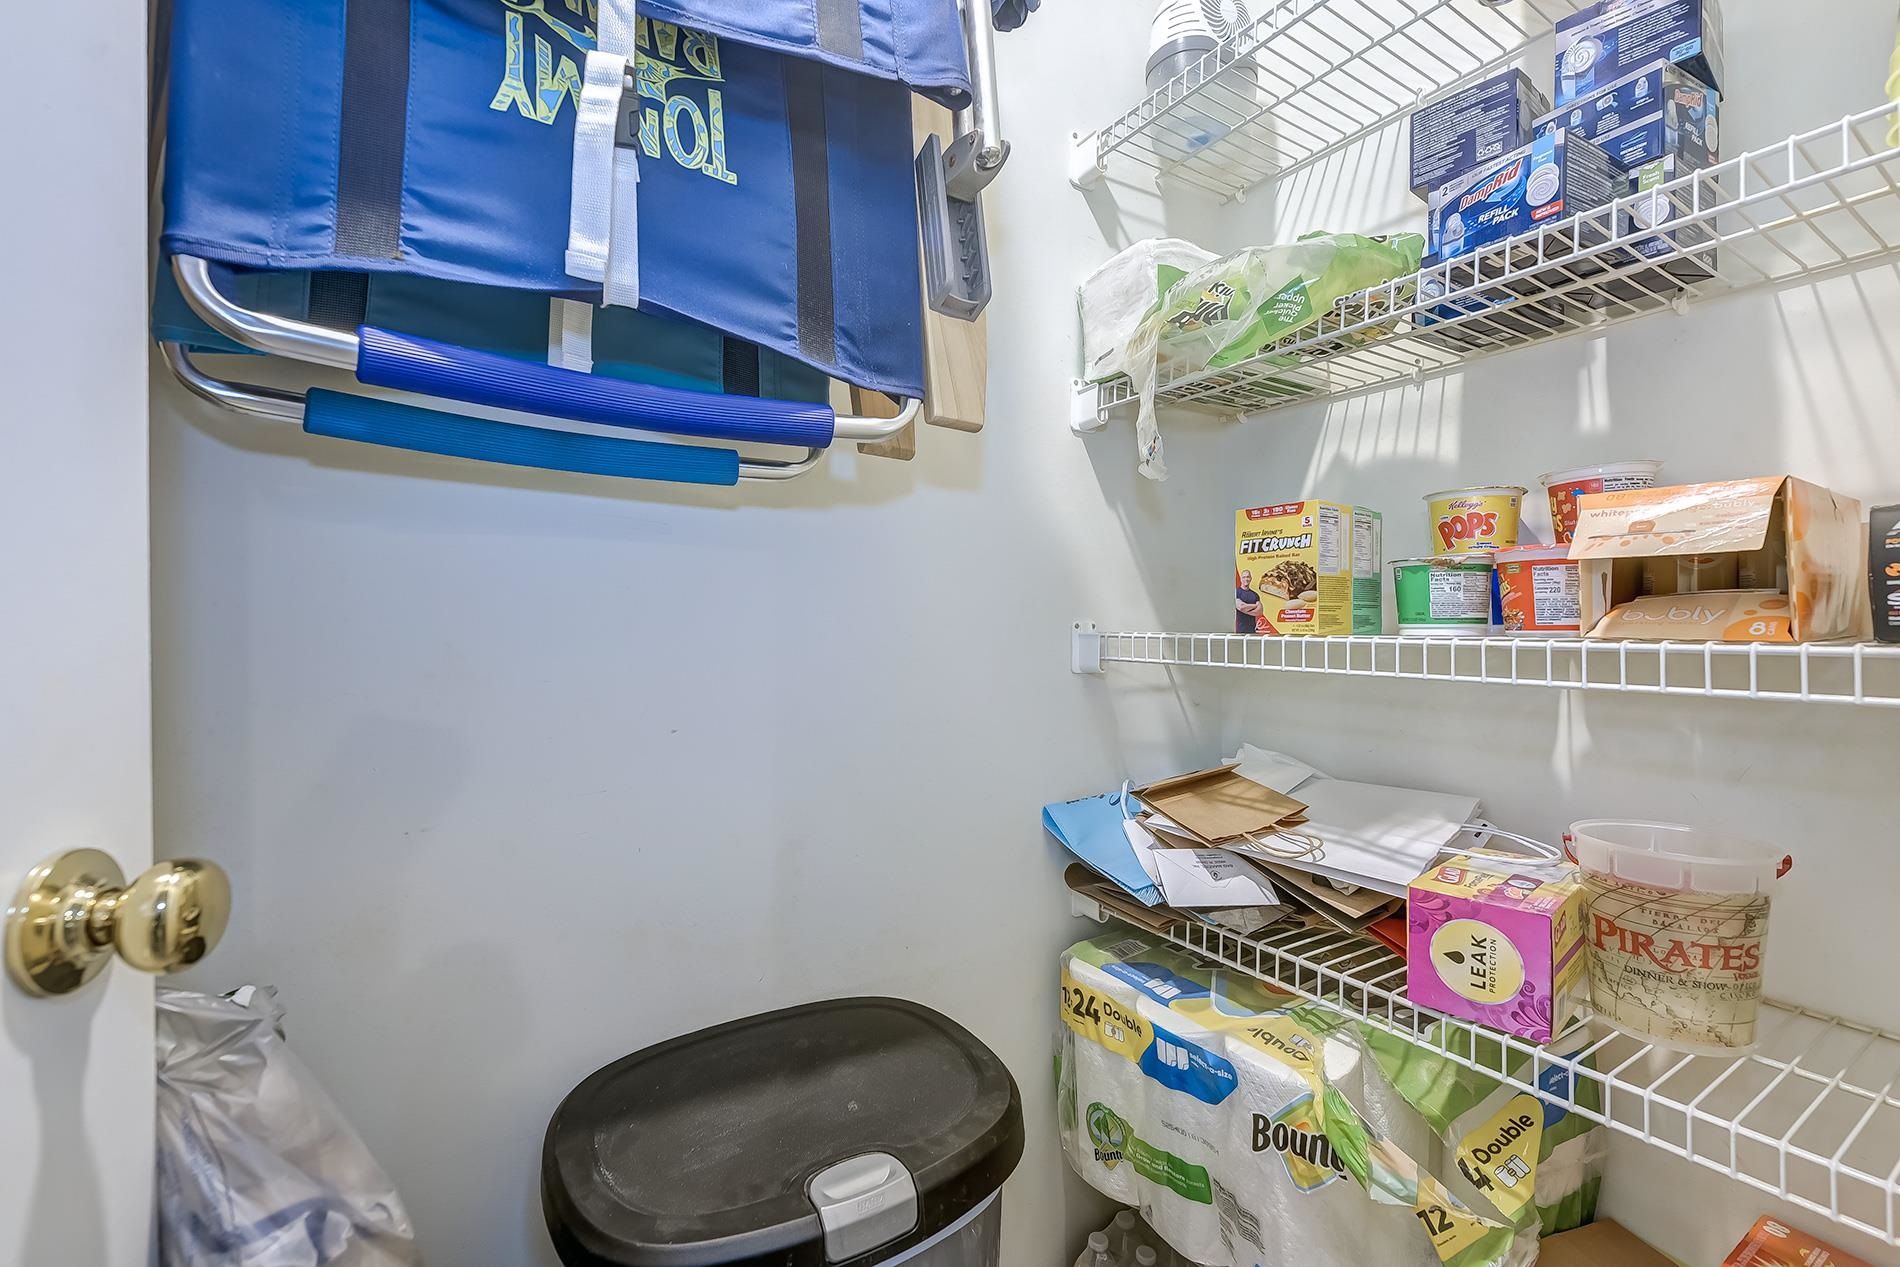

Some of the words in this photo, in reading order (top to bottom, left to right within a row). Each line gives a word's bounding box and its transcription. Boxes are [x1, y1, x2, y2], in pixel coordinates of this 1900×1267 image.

[1441, 186, 1449, 197] 2
[1459, 157, 1524, 211] DampRid
[1478, 204, 1509, 223] REFILL
[1492, 207, 1519, 225] PACK
[1278, 315, 1294, 323] The
[1448, 500, 1483, 510] Kellogg's
[1437, 512, 1498, 550] POPS
[1622, 606, 1726, 625] bubly
[1749, 621, 1766, 635] 8
[1592, 913, 1761, 974] PIRATES
[1470, 934, 1487, 990] LEAK
[1489, 938, 1497, 994] PROTECTION
[1624, 965, 1674, 984] DINNER
[1677, 978, 1688, 987] &
[1692, 980, 1729, 991] SHOW
[1104, 1001, 1142, 1038] Double
[1251, 1112, 1348, 1181] Boun
[1471, 1114, 1535, 1165] Double
[1416, 1205, 1455, 1237] 12
